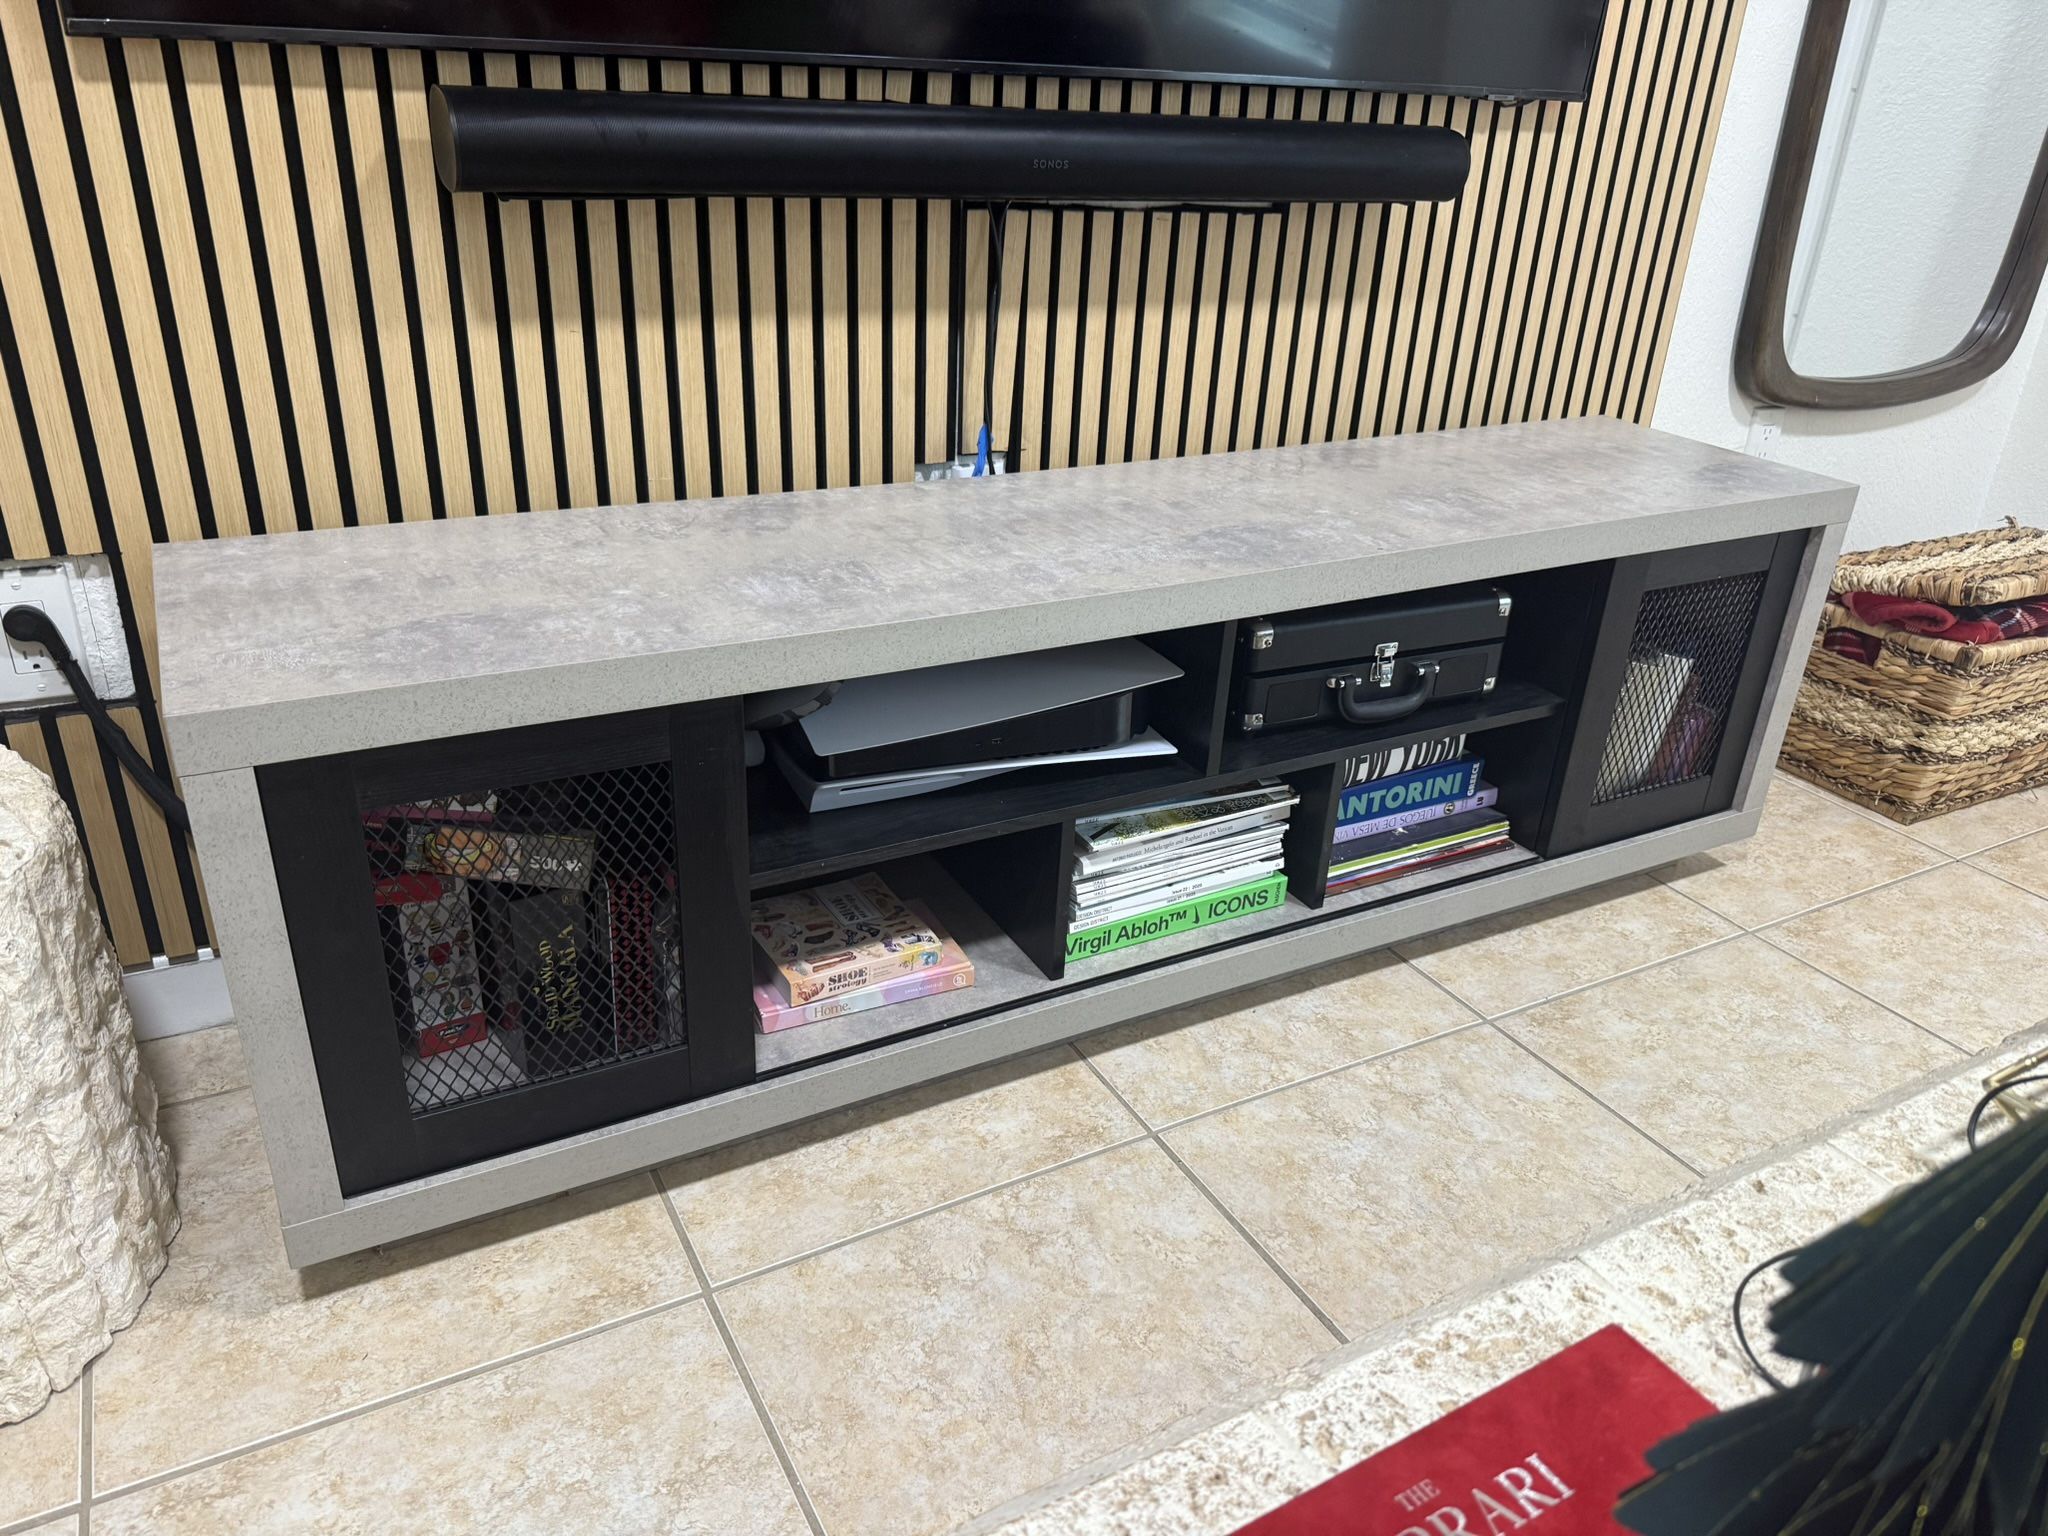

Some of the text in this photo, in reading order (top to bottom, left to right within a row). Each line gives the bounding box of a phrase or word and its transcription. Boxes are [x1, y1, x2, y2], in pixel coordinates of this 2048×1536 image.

[1033, 159, 1070, 169] SONOS
[1467, 761, 1481, 797] GREECE
[1400, 806, 1437, 824] JUEGOS
[1352, 822, 1380, 837] MESA
[1382, 817, 1398, 830] DE
[1185, 832, 1202, 844] Raphael
[1065, 929, 1112, 956] Virgil
[1207, 889, 1269, 919] ICONS
[1073, 921, 1090, 931] DESIGN
[828, 966, 868, 987] SHOE
[828, 977, 867, 993] strology
[814, 1002, 851, 1019] Home.
[1394, 1478, 1441, 1512] THE
